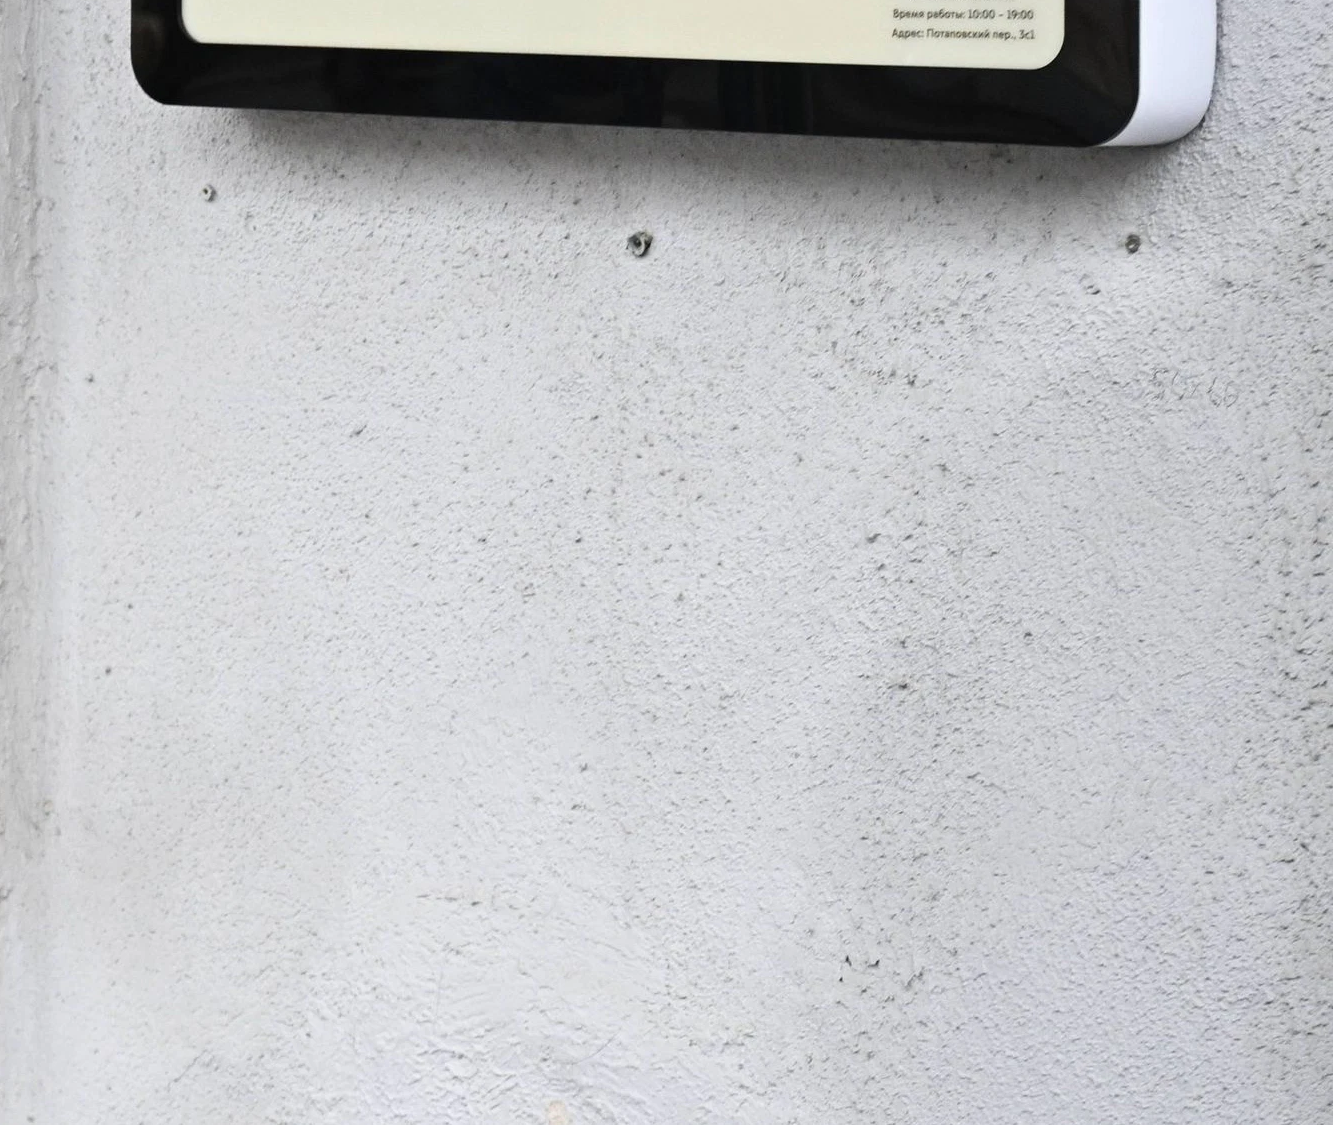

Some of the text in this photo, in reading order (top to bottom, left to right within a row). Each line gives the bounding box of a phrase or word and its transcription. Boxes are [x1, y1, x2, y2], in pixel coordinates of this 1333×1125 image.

[892, 8, 924, 20] Время
[926, 8, 965, 20] работы:
[968, 9, 996, 20] 10:00
[1007, 9, 1034, 20] 19:00
[892, 28, 925, 40] Адрес:
[926, 28, 990, 39] Потаповский
